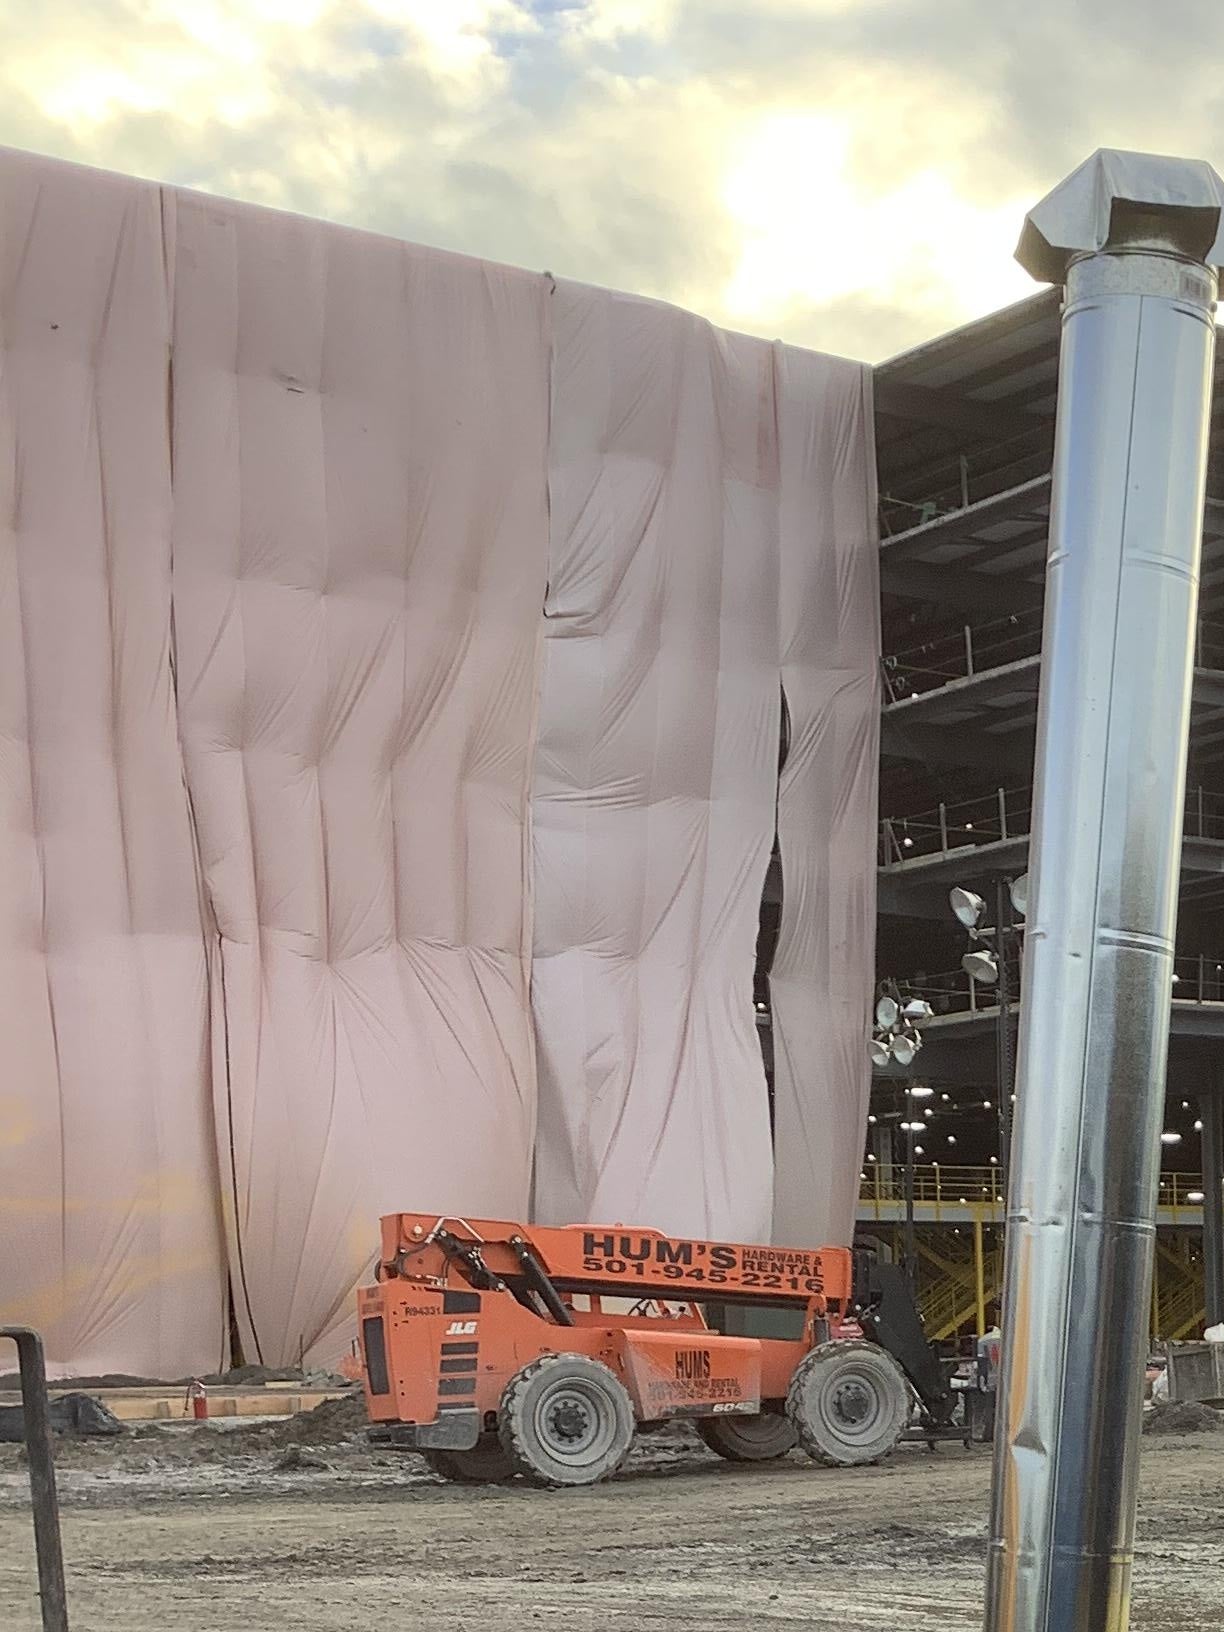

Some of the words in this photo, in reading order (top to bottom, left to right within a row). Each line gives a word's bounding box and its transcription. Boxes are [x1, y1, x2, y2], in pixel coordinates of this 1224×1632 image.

[583, 1231, 738, 1269] HUM'S
[742, 1249, 810, 1266] HARDWARE
[814, 1256, 823, 1267] &
[582, 1257, 824, 1294] 501-945-2216
[742, 1260, 824, 1278] RENTAL
[445, 1321, 478, 1336] JLG
[675, 1350, 711, 1379] HUMS
